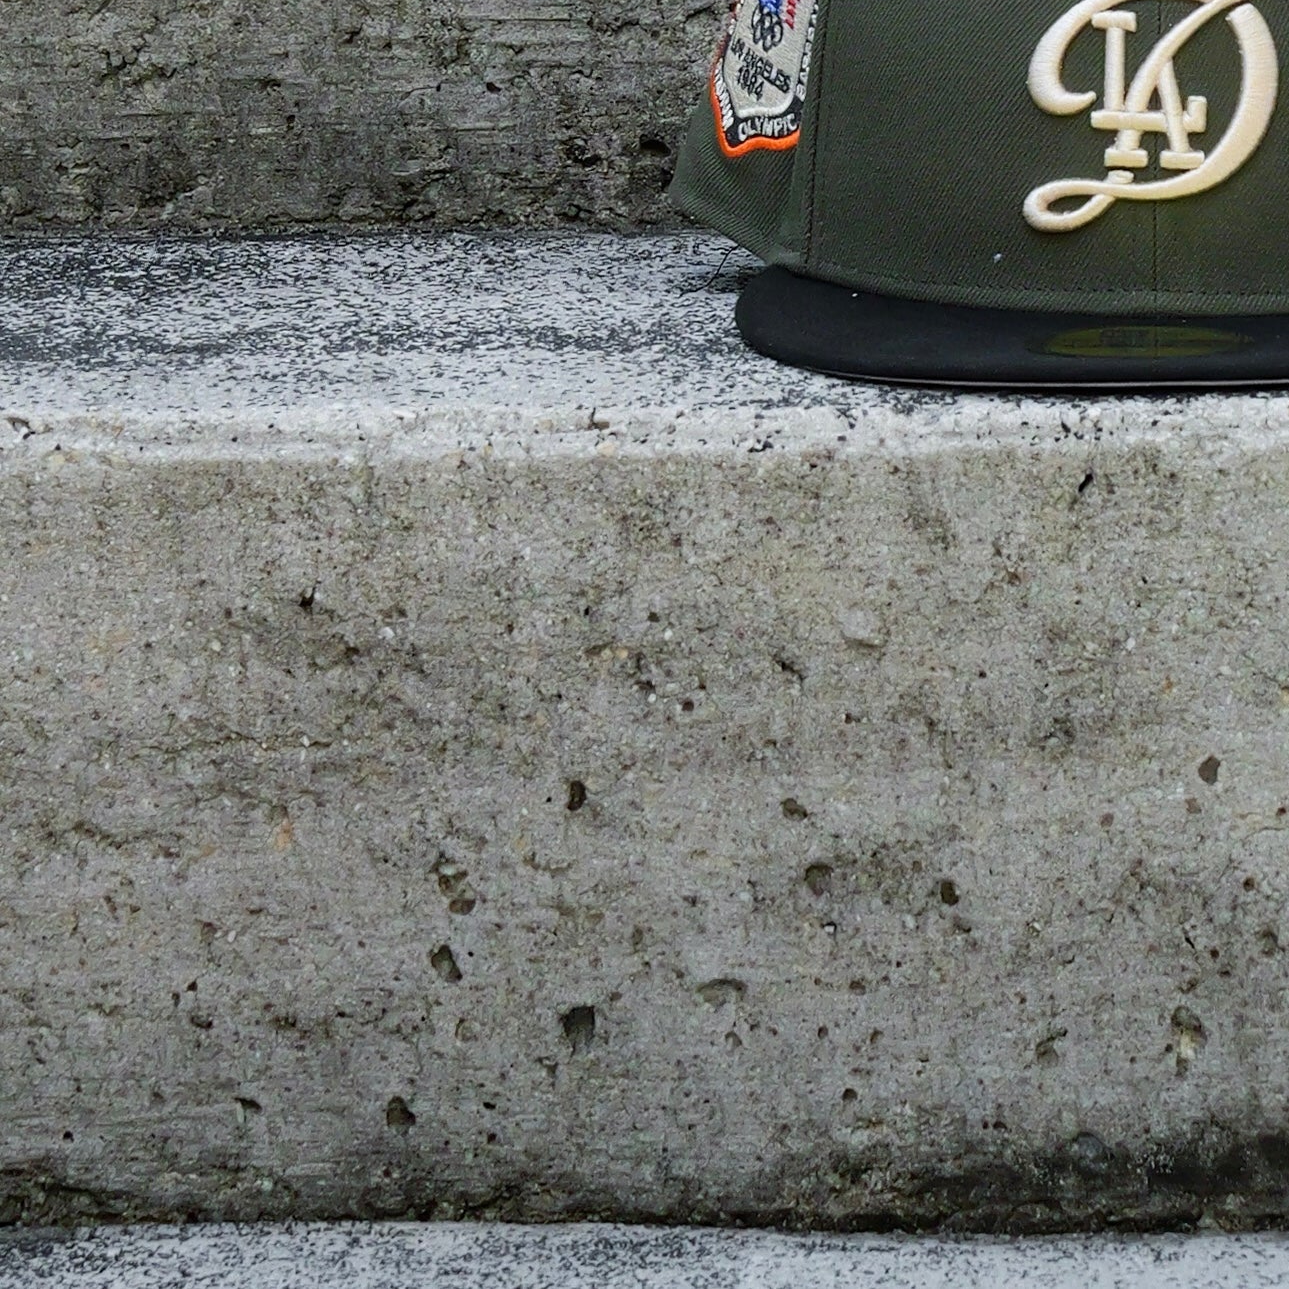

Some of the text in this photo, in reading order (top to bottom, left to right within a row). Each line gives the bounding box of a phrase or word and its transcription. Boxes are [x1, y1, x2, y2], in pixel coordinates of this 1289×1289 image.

[737, 65, 764, 101] 1984
[744, 48, 791, 94] ANGELES
[738, 113, 797, 141] OLYMPIC
